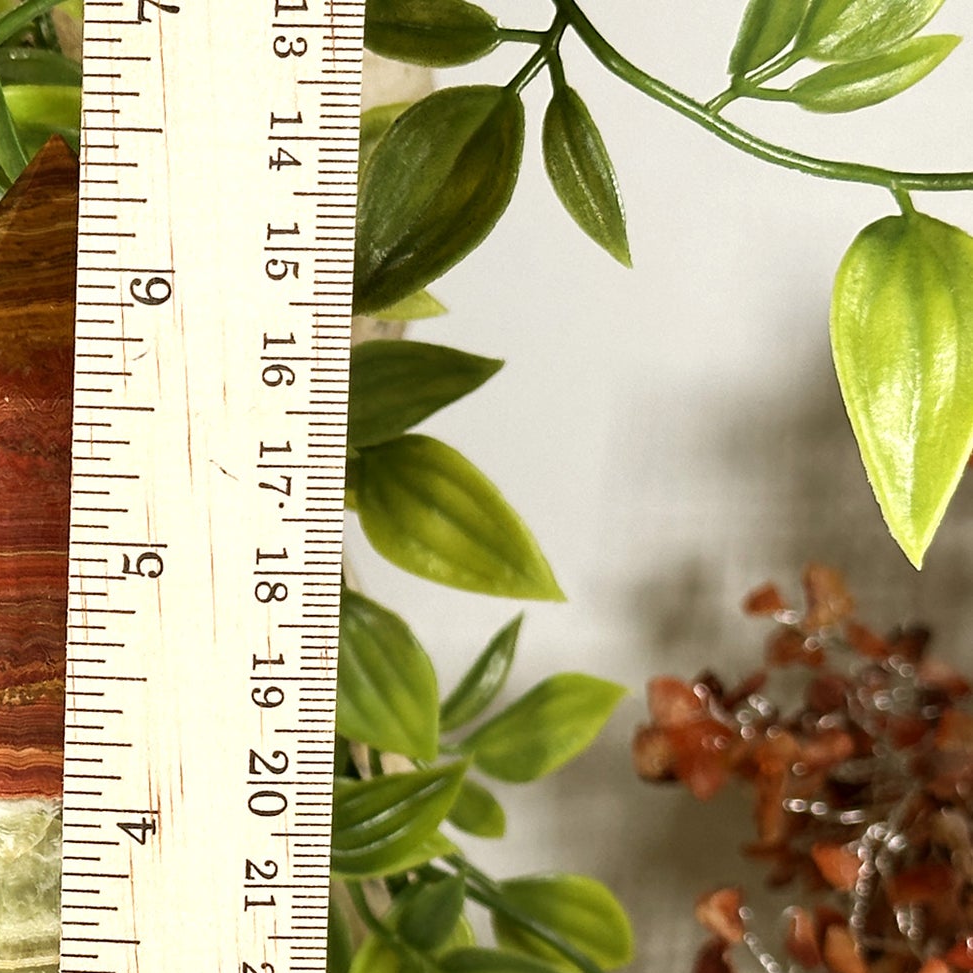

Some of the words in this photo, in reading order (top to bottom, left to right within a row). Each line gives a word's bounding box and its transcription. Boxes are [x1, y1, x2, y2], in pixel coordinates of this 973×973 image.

[273, 0, 309, 59] 13
[268, 111, 303, 172] 14
[265, 222, 301, 281] 15
[129, 276, 172, 306] 6
[261, 332, 297, 387] 16
[258, 440, 292, 497] 17
[121, 551, 164, 579] 5
[254, 547, 289, 604] 18
[251, 653, 285, 709] 19
[247, 748, 289, 817] 20
[116, 816, 157, 846] 4
[244, 858, 279, 912] 21
